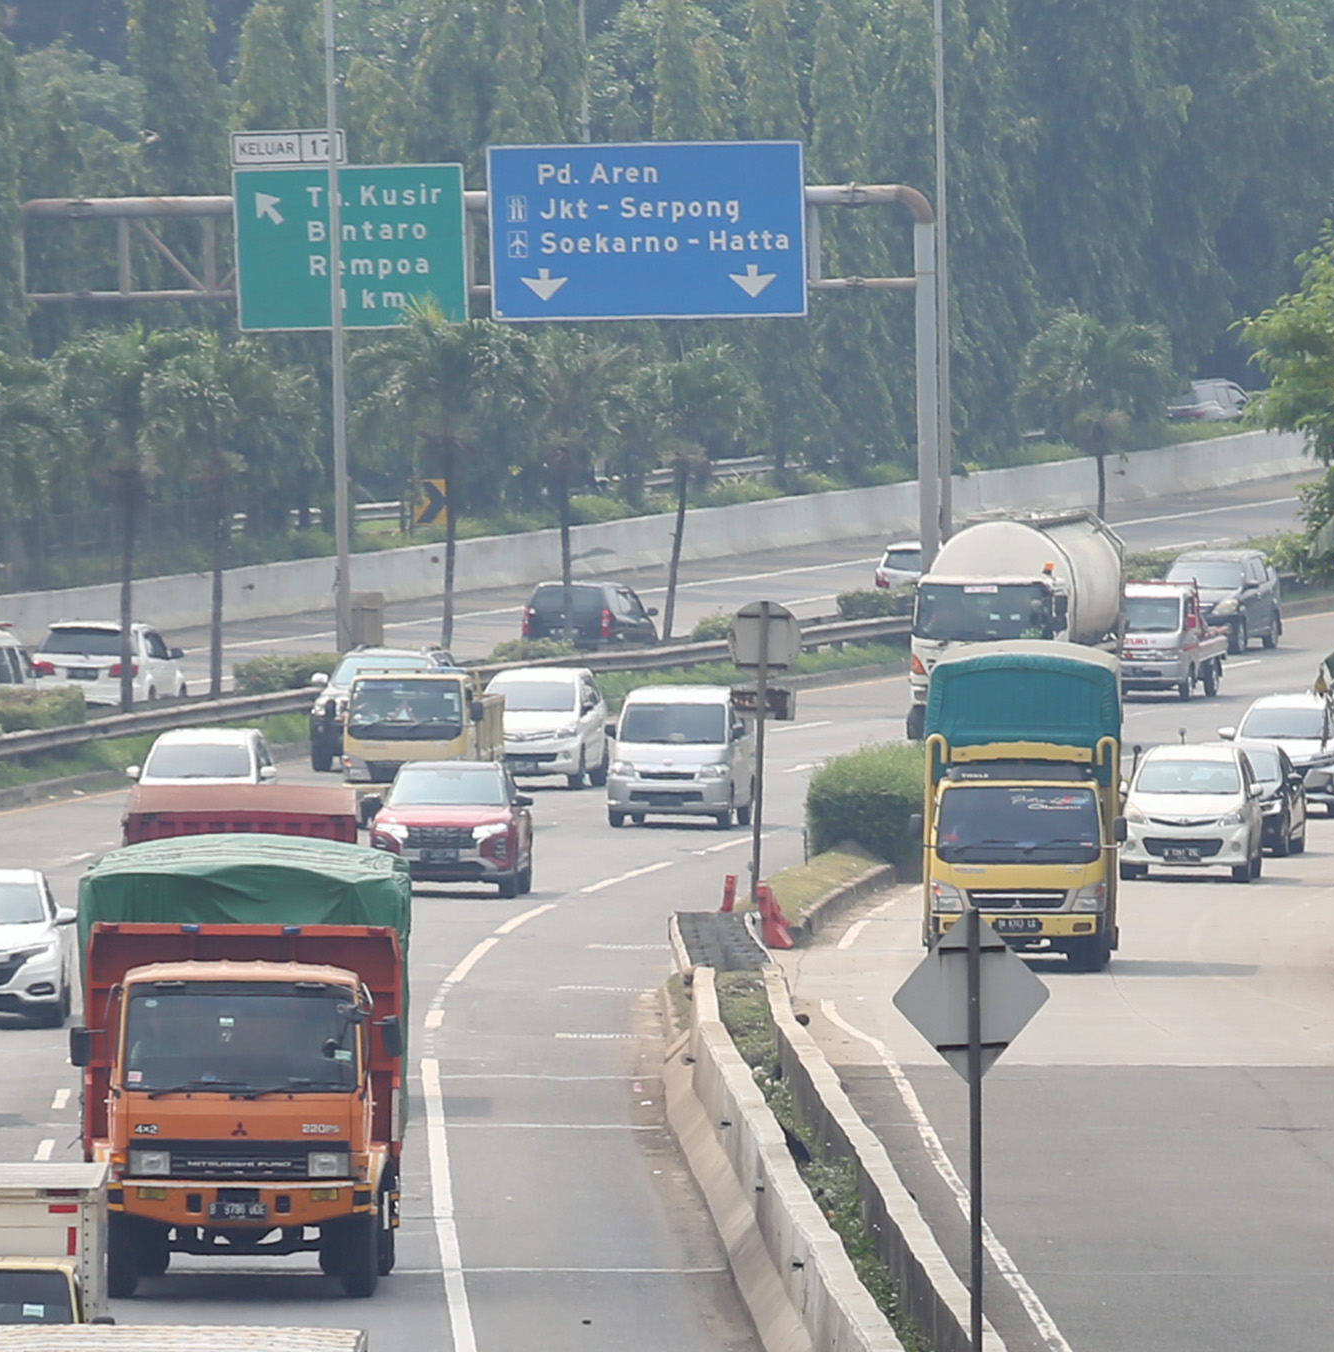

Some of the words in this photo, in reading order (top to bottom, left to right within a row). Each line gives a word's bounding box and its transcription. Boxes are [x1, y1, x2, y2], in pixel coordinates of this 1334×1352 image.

[238, 141, 296, 157] KELUAR
[310, 138, 330, 156] 17
[537, 163, 579, 185] Pd.
[590, 162, 658, 184] Aren
[360, 183, 442, 207] Kusir
[540, 198, 588, 220] Jkt
[620, 196, 740, 223] Serpong
[307, 220, 427, 242] Bntaro
[540, 231, 679, 254] Soekarno
[708, 229, 790, 251] Hatta
[362, 288, 406, 309] km
